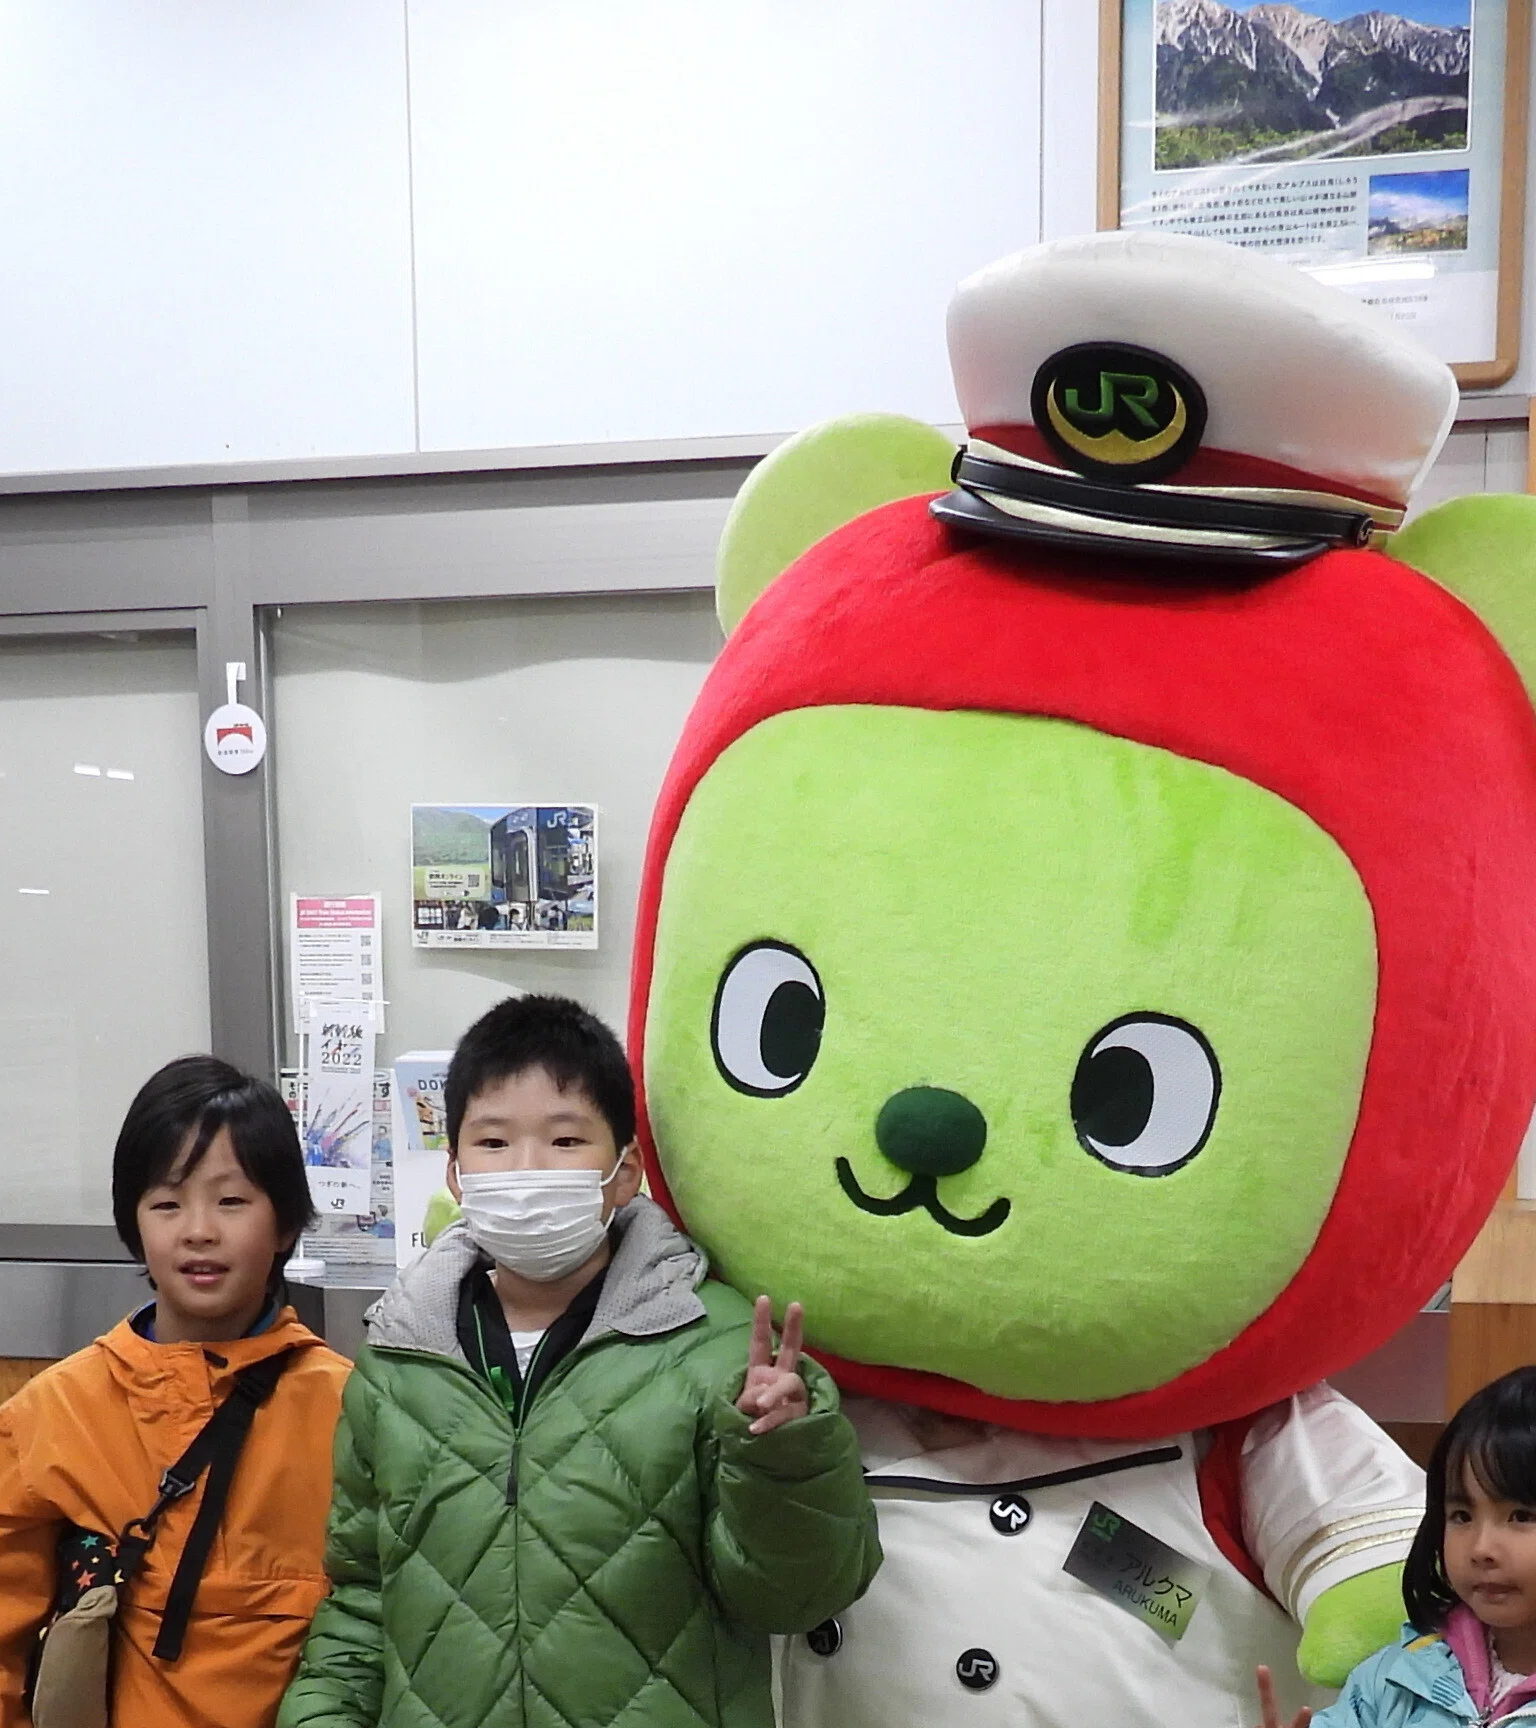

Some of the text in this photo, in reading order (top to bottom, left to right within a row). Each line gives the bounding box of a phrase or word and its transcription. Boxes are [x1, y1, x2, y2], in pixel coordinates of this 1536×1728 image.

[1064, 372, 1162, 431] JR
[546, 810, 568, 829] JR
[320, 1051, 363, 1066] 2022
[992, 1499, 1029, 1531] JR
[1119, 1551, 1193, 1609] アルクマ
[1111, 1579, 1178, 1628] ARUKUMA
[958, 1658, 996, 1682] JR
